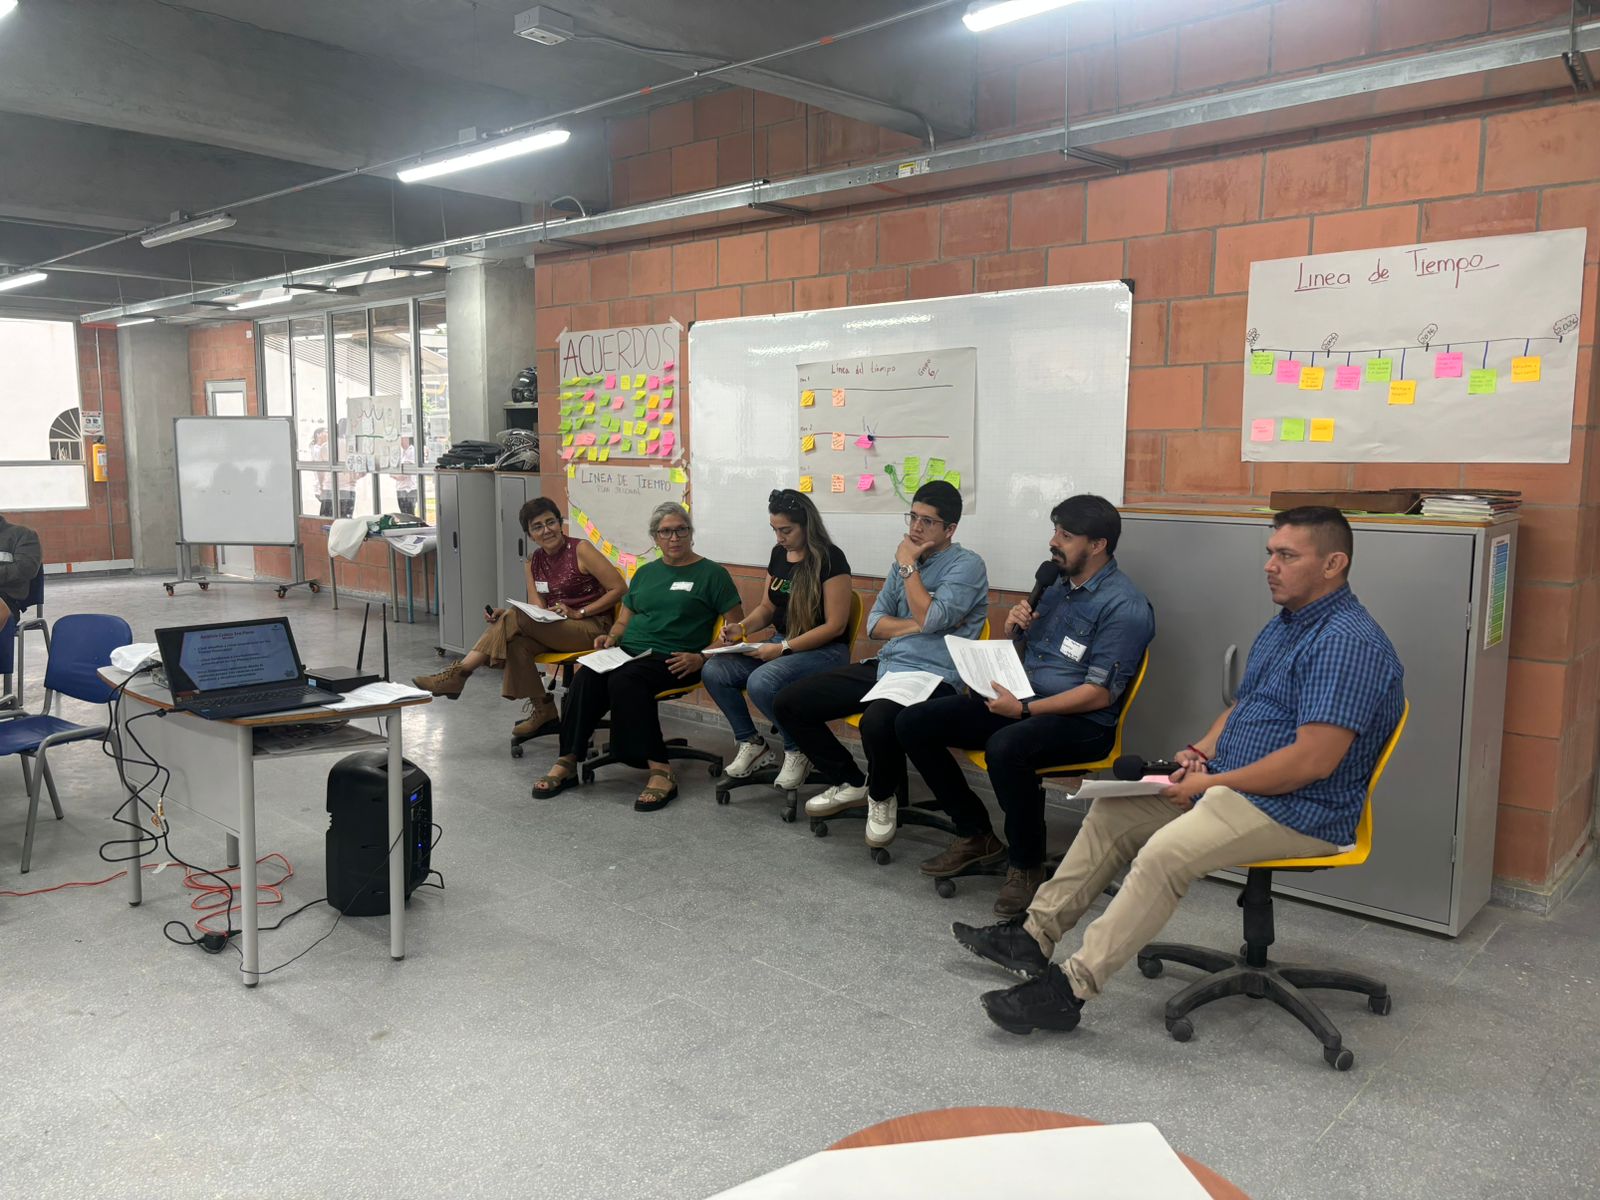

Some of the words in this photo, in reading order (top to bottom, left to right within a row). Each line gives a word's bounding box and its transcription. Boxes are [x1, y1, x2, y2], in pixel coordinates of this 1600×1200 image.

[1368, 258, 1389, 282] de
[1405, 248, 1484, 289] Tiempo
[563, 326, 676, 378] ACUERDOS
[581, 469, 613, 484] LINEA
[616, 473, 629, 487] DE
[634, 474, 672, 492] TIEMPO
